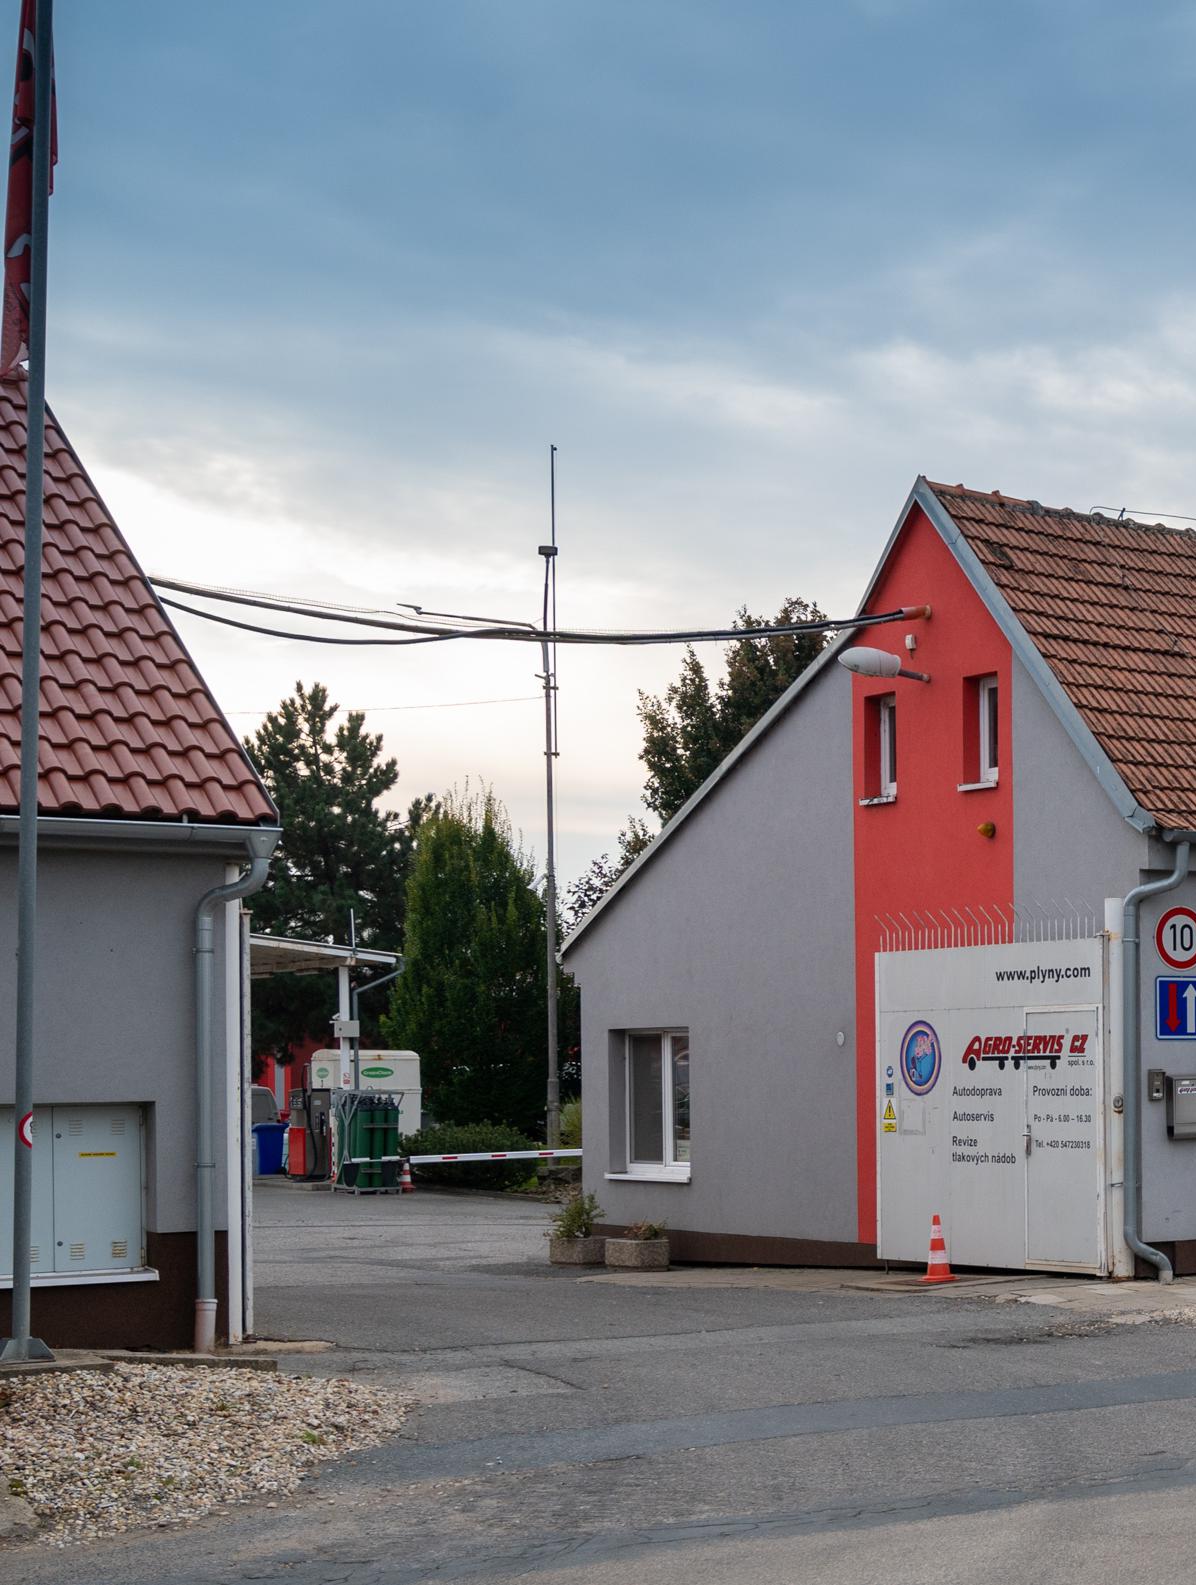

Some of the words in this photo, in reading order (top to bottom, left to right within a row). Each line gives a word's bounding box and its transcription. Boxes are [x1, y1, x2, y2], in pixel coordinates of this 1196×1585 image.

[1169, 923, 1193, 951] 10
[995, 965, 1091, 984] www.plyny.com
[1069, 1034, 1088, 1054] CZ
[1067, 1059, 1081, 1067] spol.
[952, 1085, 1002, 1099] Autodoprava
[1032, 1085, 1068, 1096] Provozní
[1069, 1085, 1092, 1096] doba:
[952, 1110, 994, 1122] Autoservis
[1033, 1114, 1042, 1123] Po
[952, 1136, 978, 1147] Revize
[1035, 1140, 1046, 1149] Tel.
[1046, 1140, 1060, 1149] +420
[952, 1151, 989, 1165] tlakových
[991, 1152, 1016, 1164] nádob
